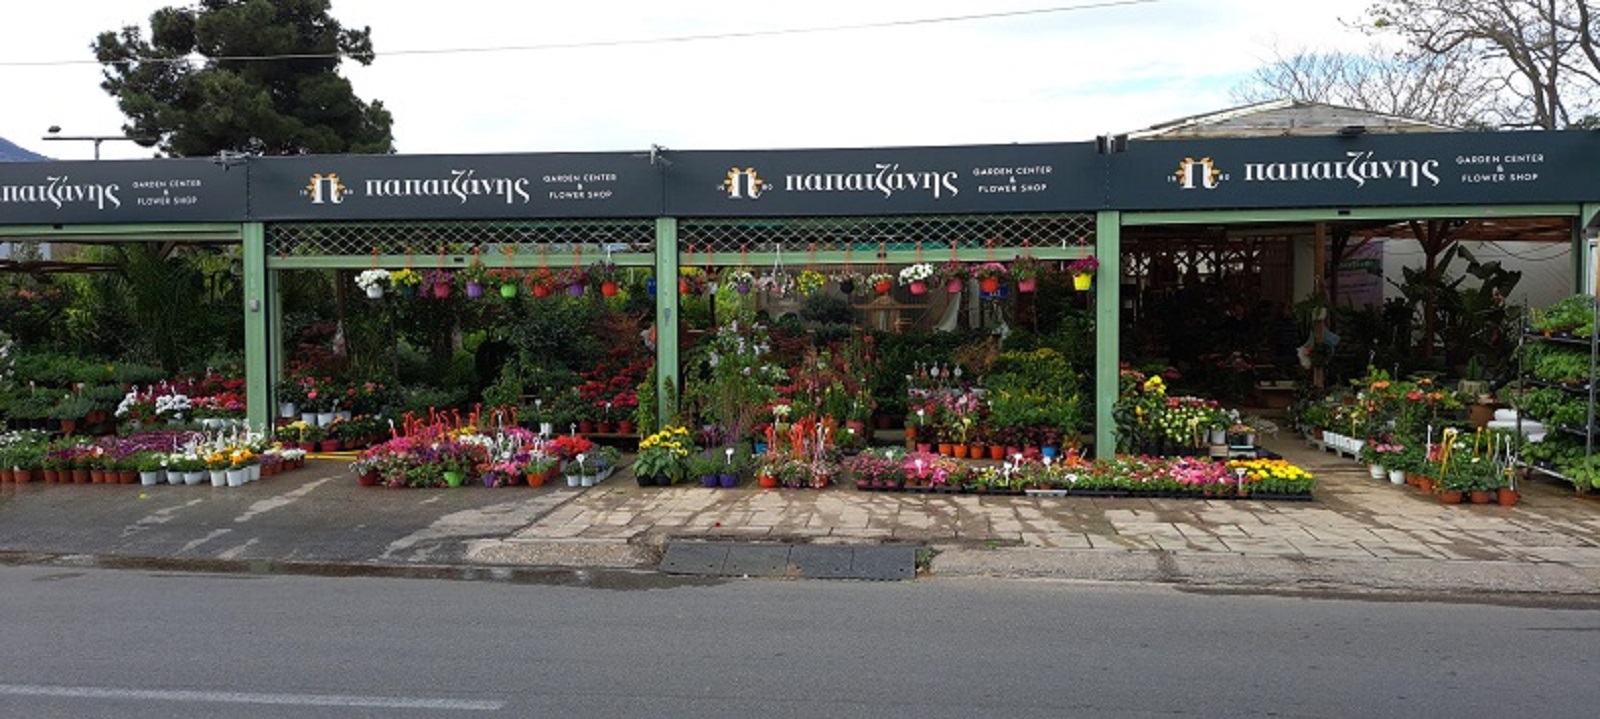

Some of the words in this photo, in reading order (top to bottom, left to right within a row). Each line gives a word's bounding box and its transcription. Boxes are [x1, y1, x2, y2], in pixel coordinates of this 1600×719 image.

[1456, 156, 1500, 165] GARDEN
[1504, 154, 1544, 163] CENTER
[973, 168, 1012, 176] GARDEN
[1015, 166, 1053, 175] CENTER
[1245, 151, 1439, 187] παπατζάνης
[543, 175, 578, 183] GARDEN
[583, 174, 617, 182] CENTER
[786, 164, 958, 198] παπατζάνης
[1461, 174, 1506, 183] FLOWER
[1510, 173, 1538, 182] SHOP
[366, 170, 529, 204] παπατζάνης
[978, 185, 1017, 193] FLOWER
[1021, 184, 1047, 192] SHOP
[0, 176, 120, 209] πατζάνης
[549, 191, 585, 199] FLOWER
[588, 190, 613, 199] SHOP
[137, 197, 170, 205] FLOWER
[173, 196, 198, 204] SHOP
